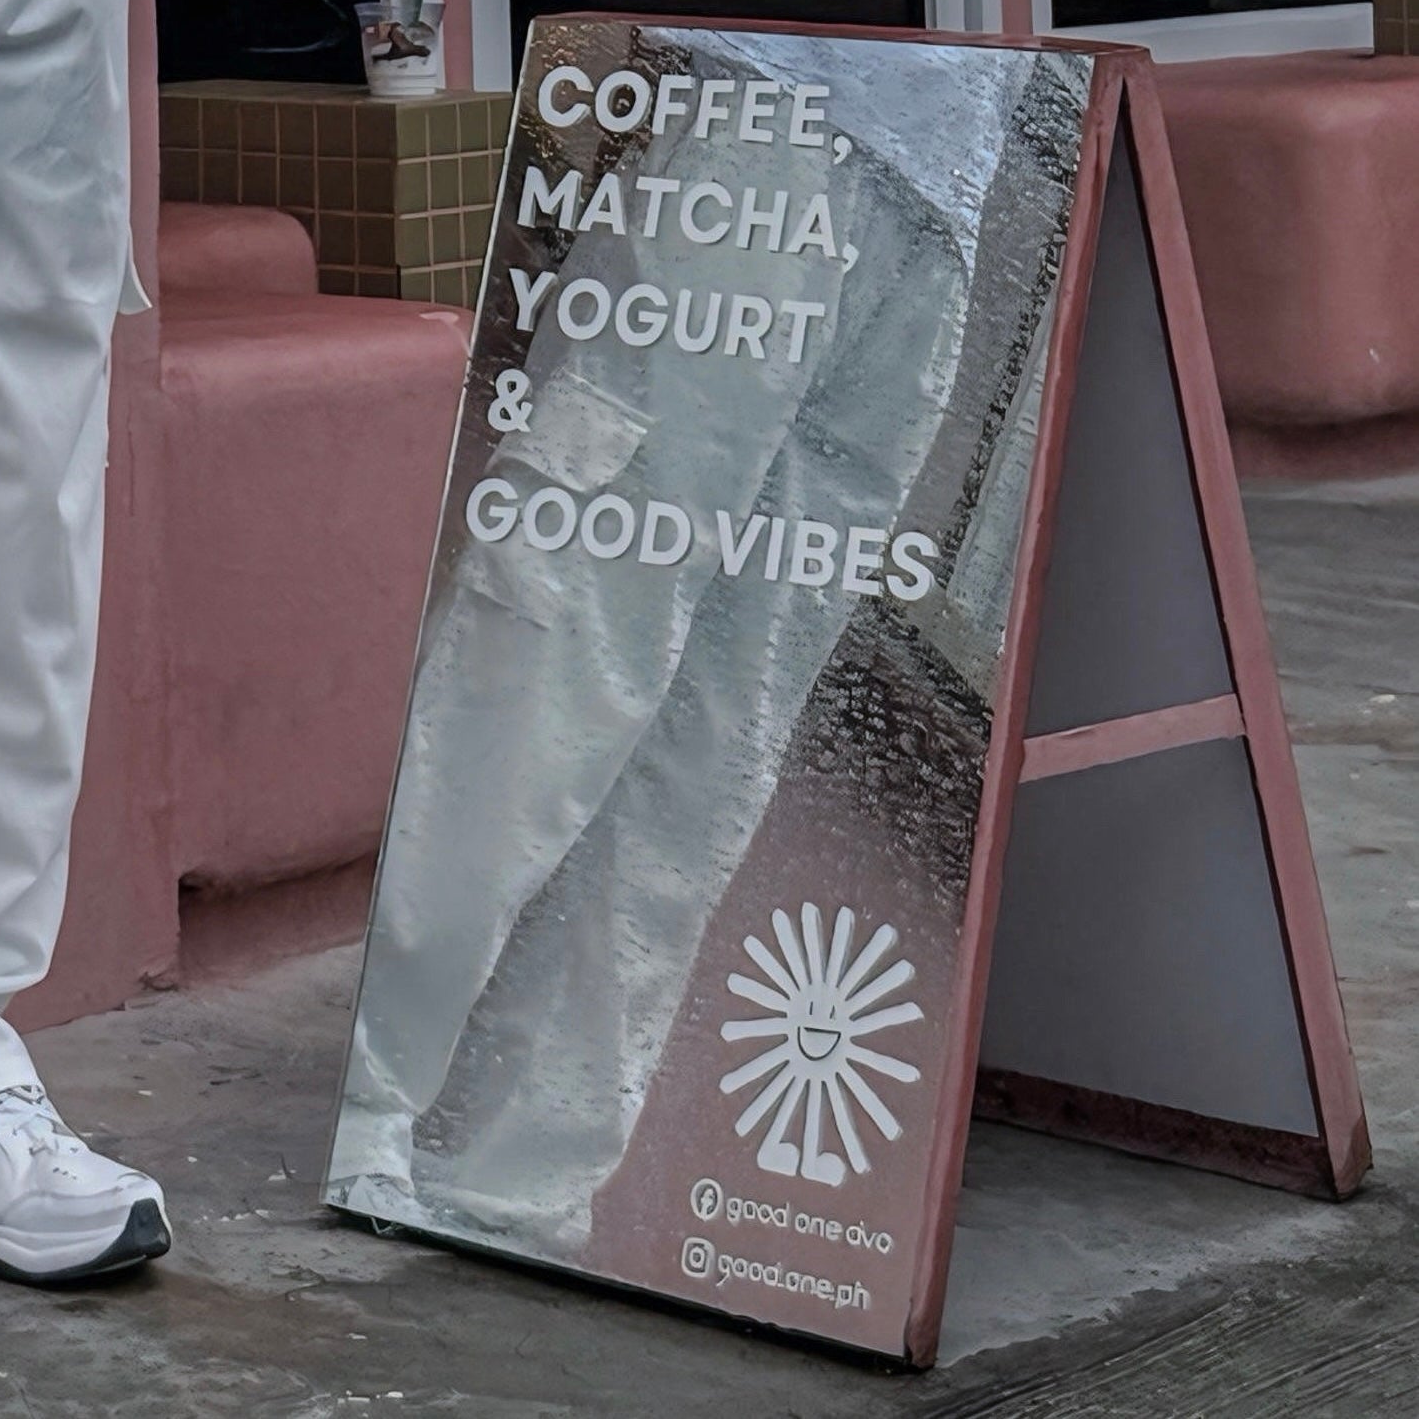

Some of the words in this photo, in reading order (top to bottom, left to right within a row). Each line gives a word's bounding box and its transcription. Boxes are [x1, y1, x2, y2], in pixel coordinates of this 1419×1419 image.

[538, 66, 852, 164] COFFEE,
[519, 166, 859, 272] MATCHA,
[510, 268, 826, 363] YOGURT
[487, 369, 533, 433] &
[466, 478, 691, 566] GOOD
[715, 511, 939, 601] VIBES
